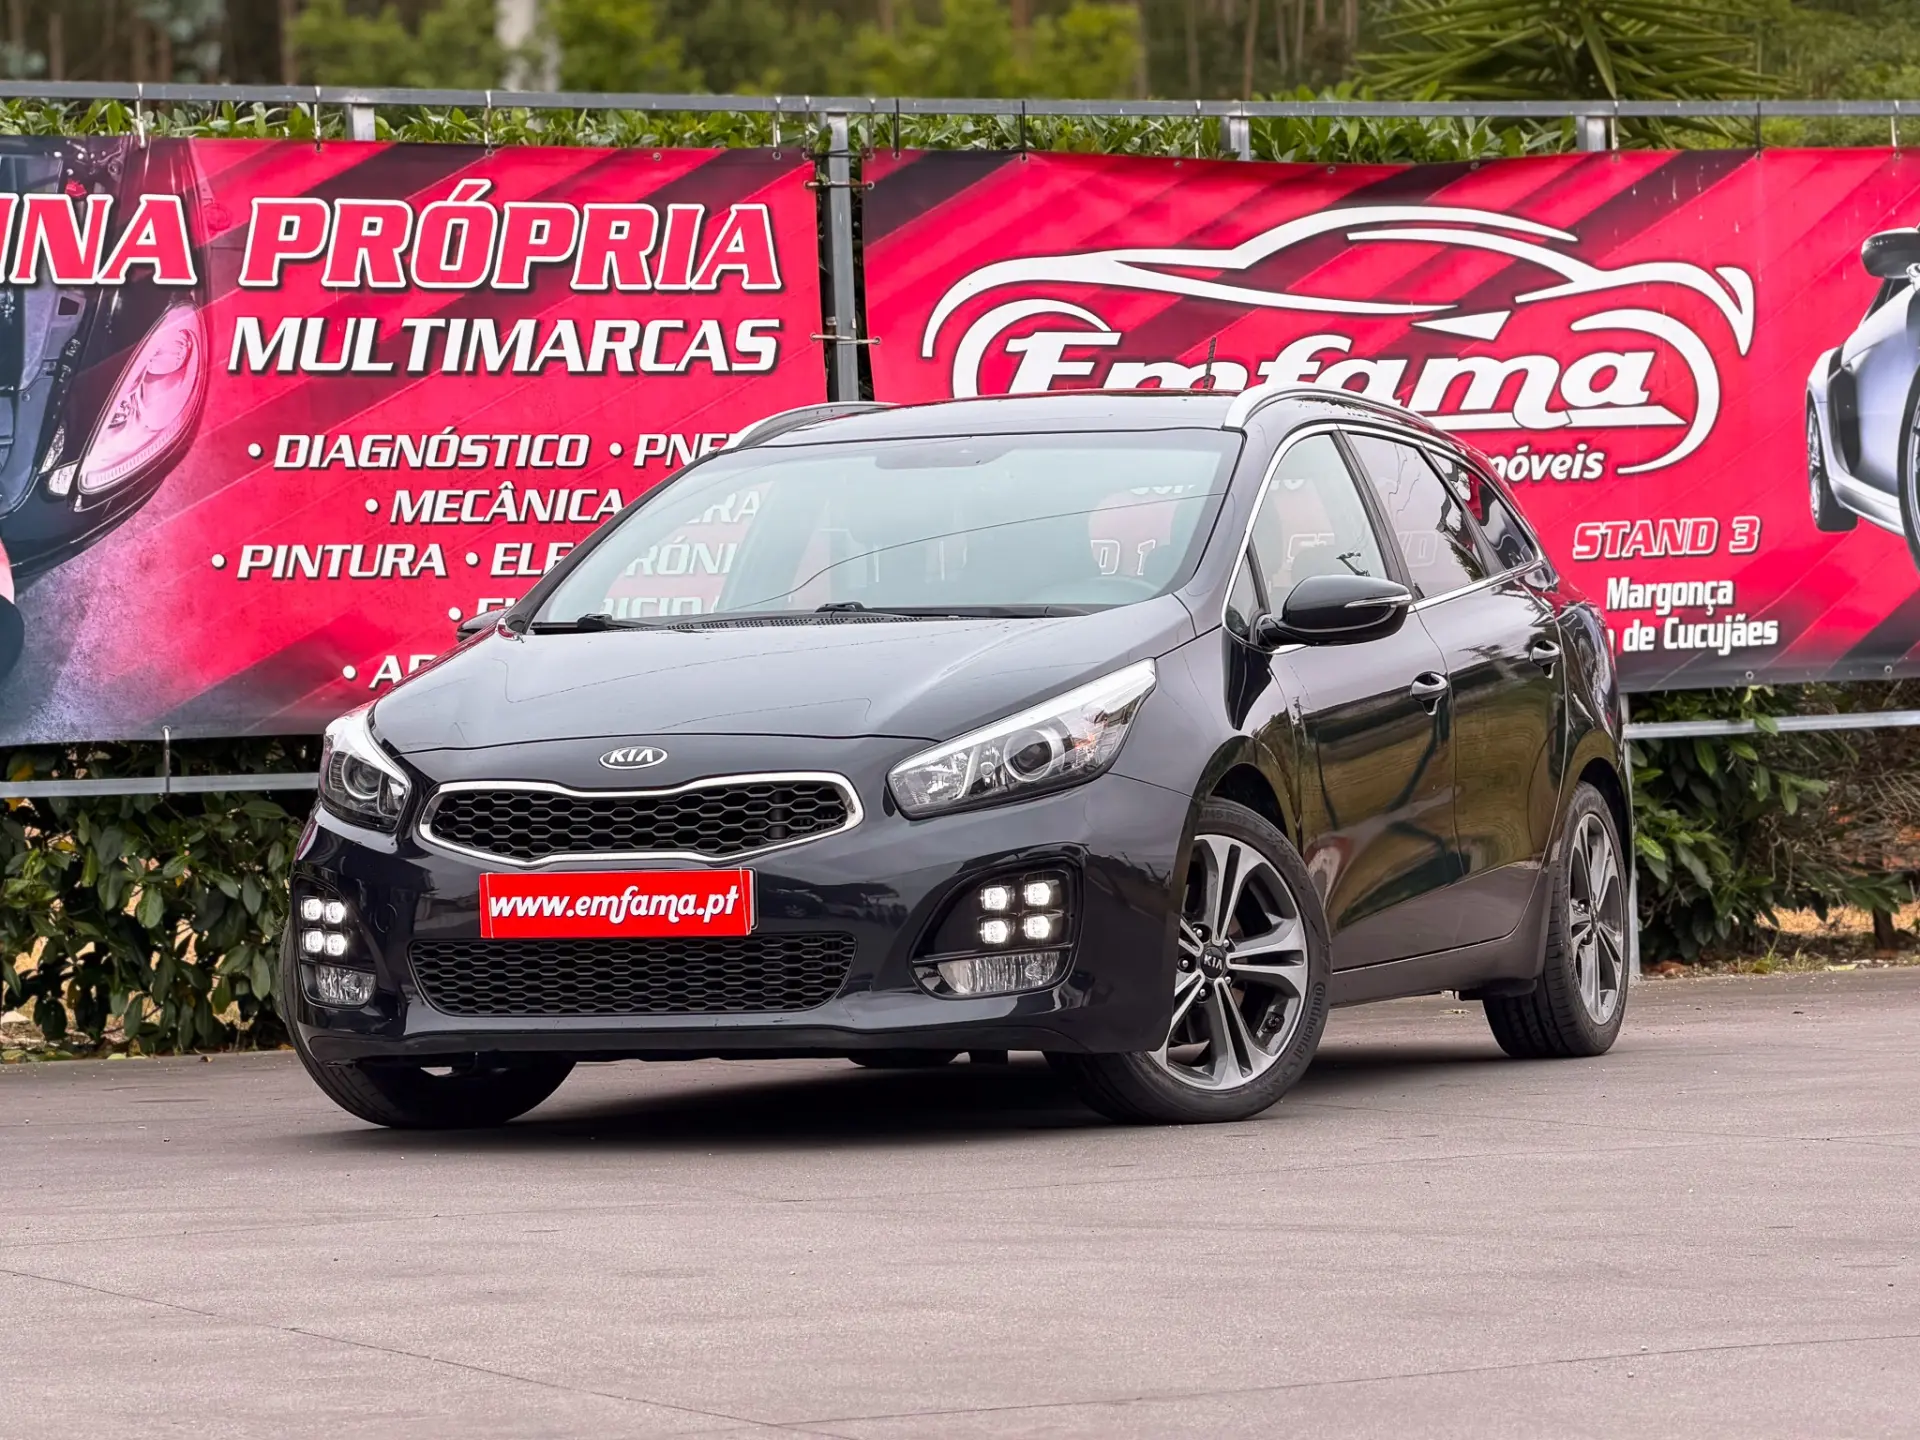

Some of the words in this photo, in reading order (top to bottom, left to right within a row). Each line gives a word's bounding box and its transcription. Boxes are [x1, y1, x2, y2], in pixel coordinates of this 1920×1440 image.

[238, 178, 782, 290] PRÓPRIA
[228, 317, 781, 373] MULTIMARCAS
[273, 425, 591, 468] DIAGNÓSTICO
[390, 480, 624, 523] MECÂNICA
[1573, 517, 1720, 560] STAND
[1729, 515, 1761, 553] 3
[237, 543, 447, 579] PINTURA
[1606, 577, 1734, 616] Margonça
[1623, 619, 1656, 652] de
[1663, 613, 1779, 656] Cucujães
[608, 748, 654, 764] KIA
[489, 885, 740, 924] www.emfama.pt
[1203, 953, 1223, 970] KIA
